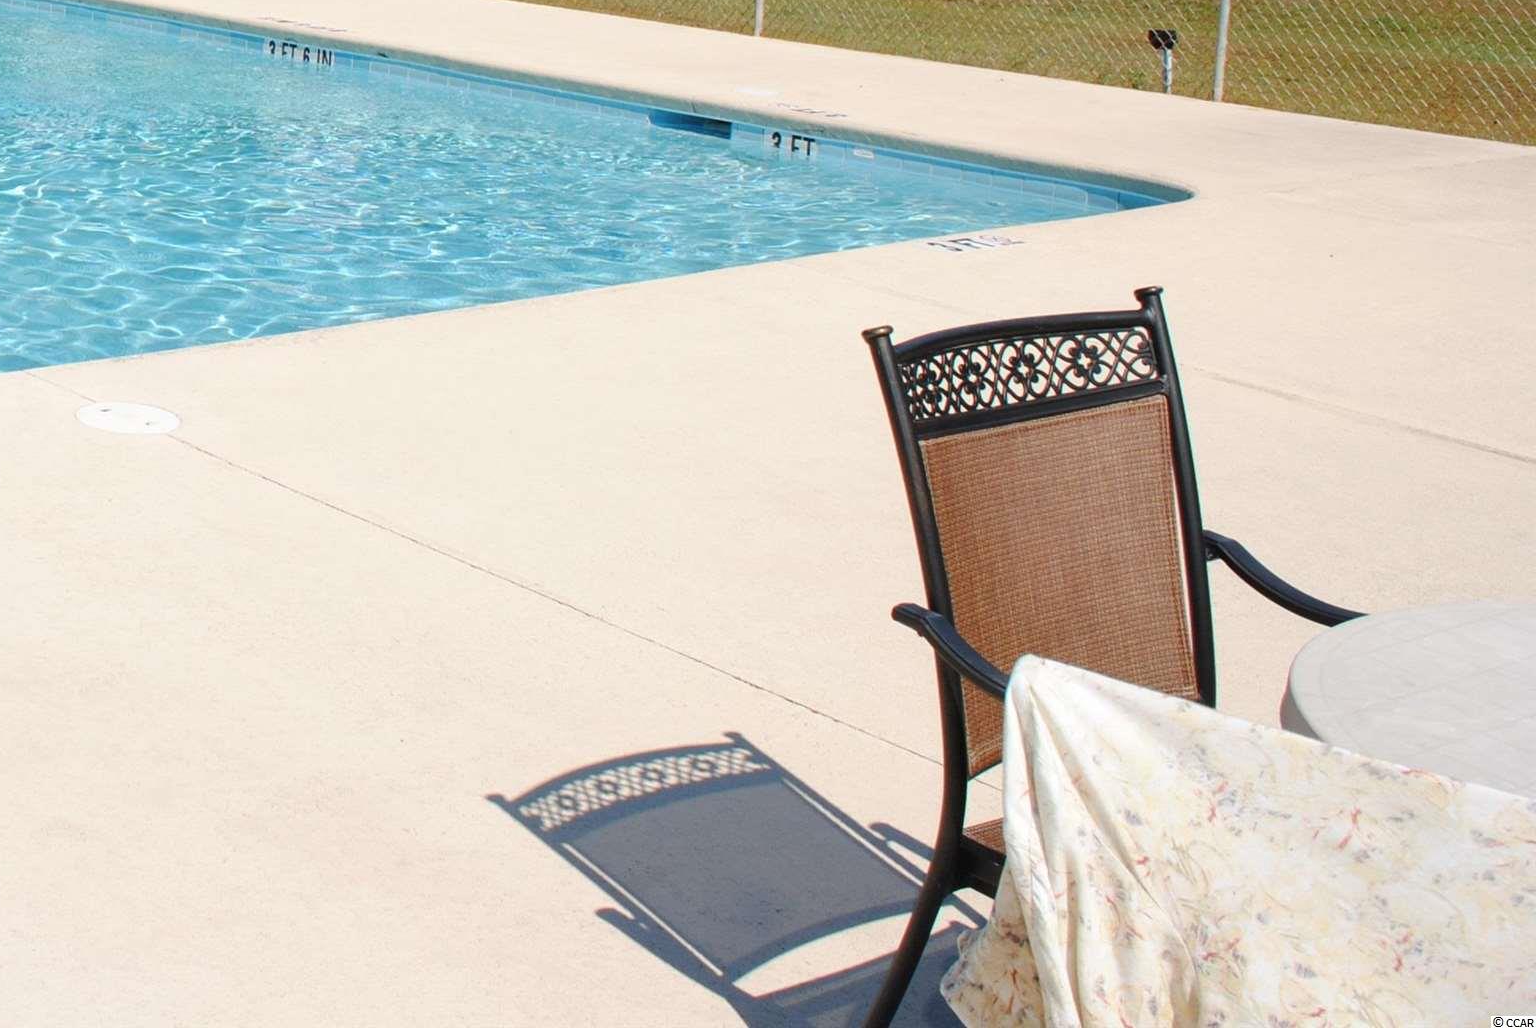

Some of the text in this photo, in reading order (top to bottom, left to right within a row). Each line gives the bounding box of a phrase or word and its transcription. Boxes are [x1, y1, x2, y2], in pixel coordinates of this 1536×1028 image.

[282, 42, 297, 58] FT
[317, 48, 333, 67] IN
[791, 134, 816, 156] FT
